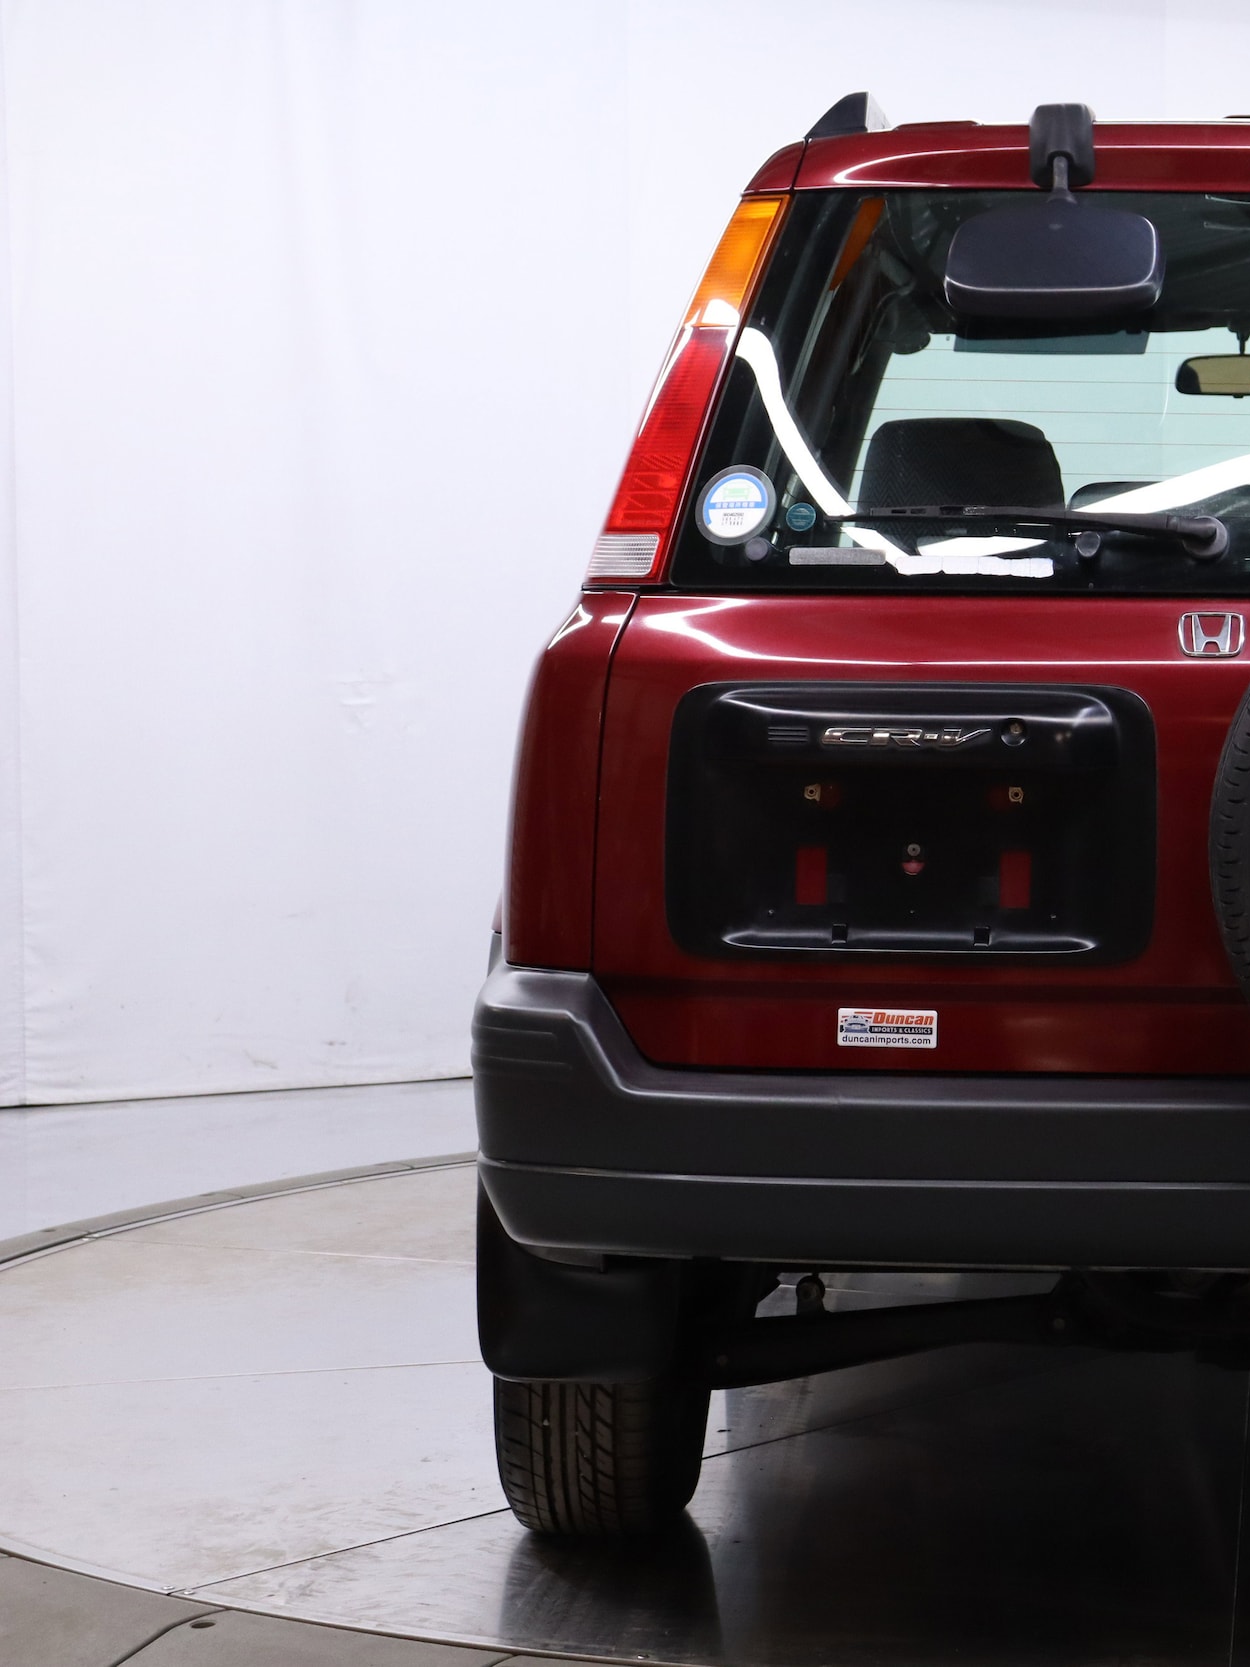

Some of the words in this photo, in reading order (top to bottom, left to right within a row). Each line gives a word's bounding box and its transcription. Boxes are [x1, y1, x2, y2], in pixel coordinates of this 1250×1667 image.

[821, 727, 991, 747] CR-V
[873, 1012, 934, 1025] Duncan
[842, 1035, 931, 1045] duncanimports.com
